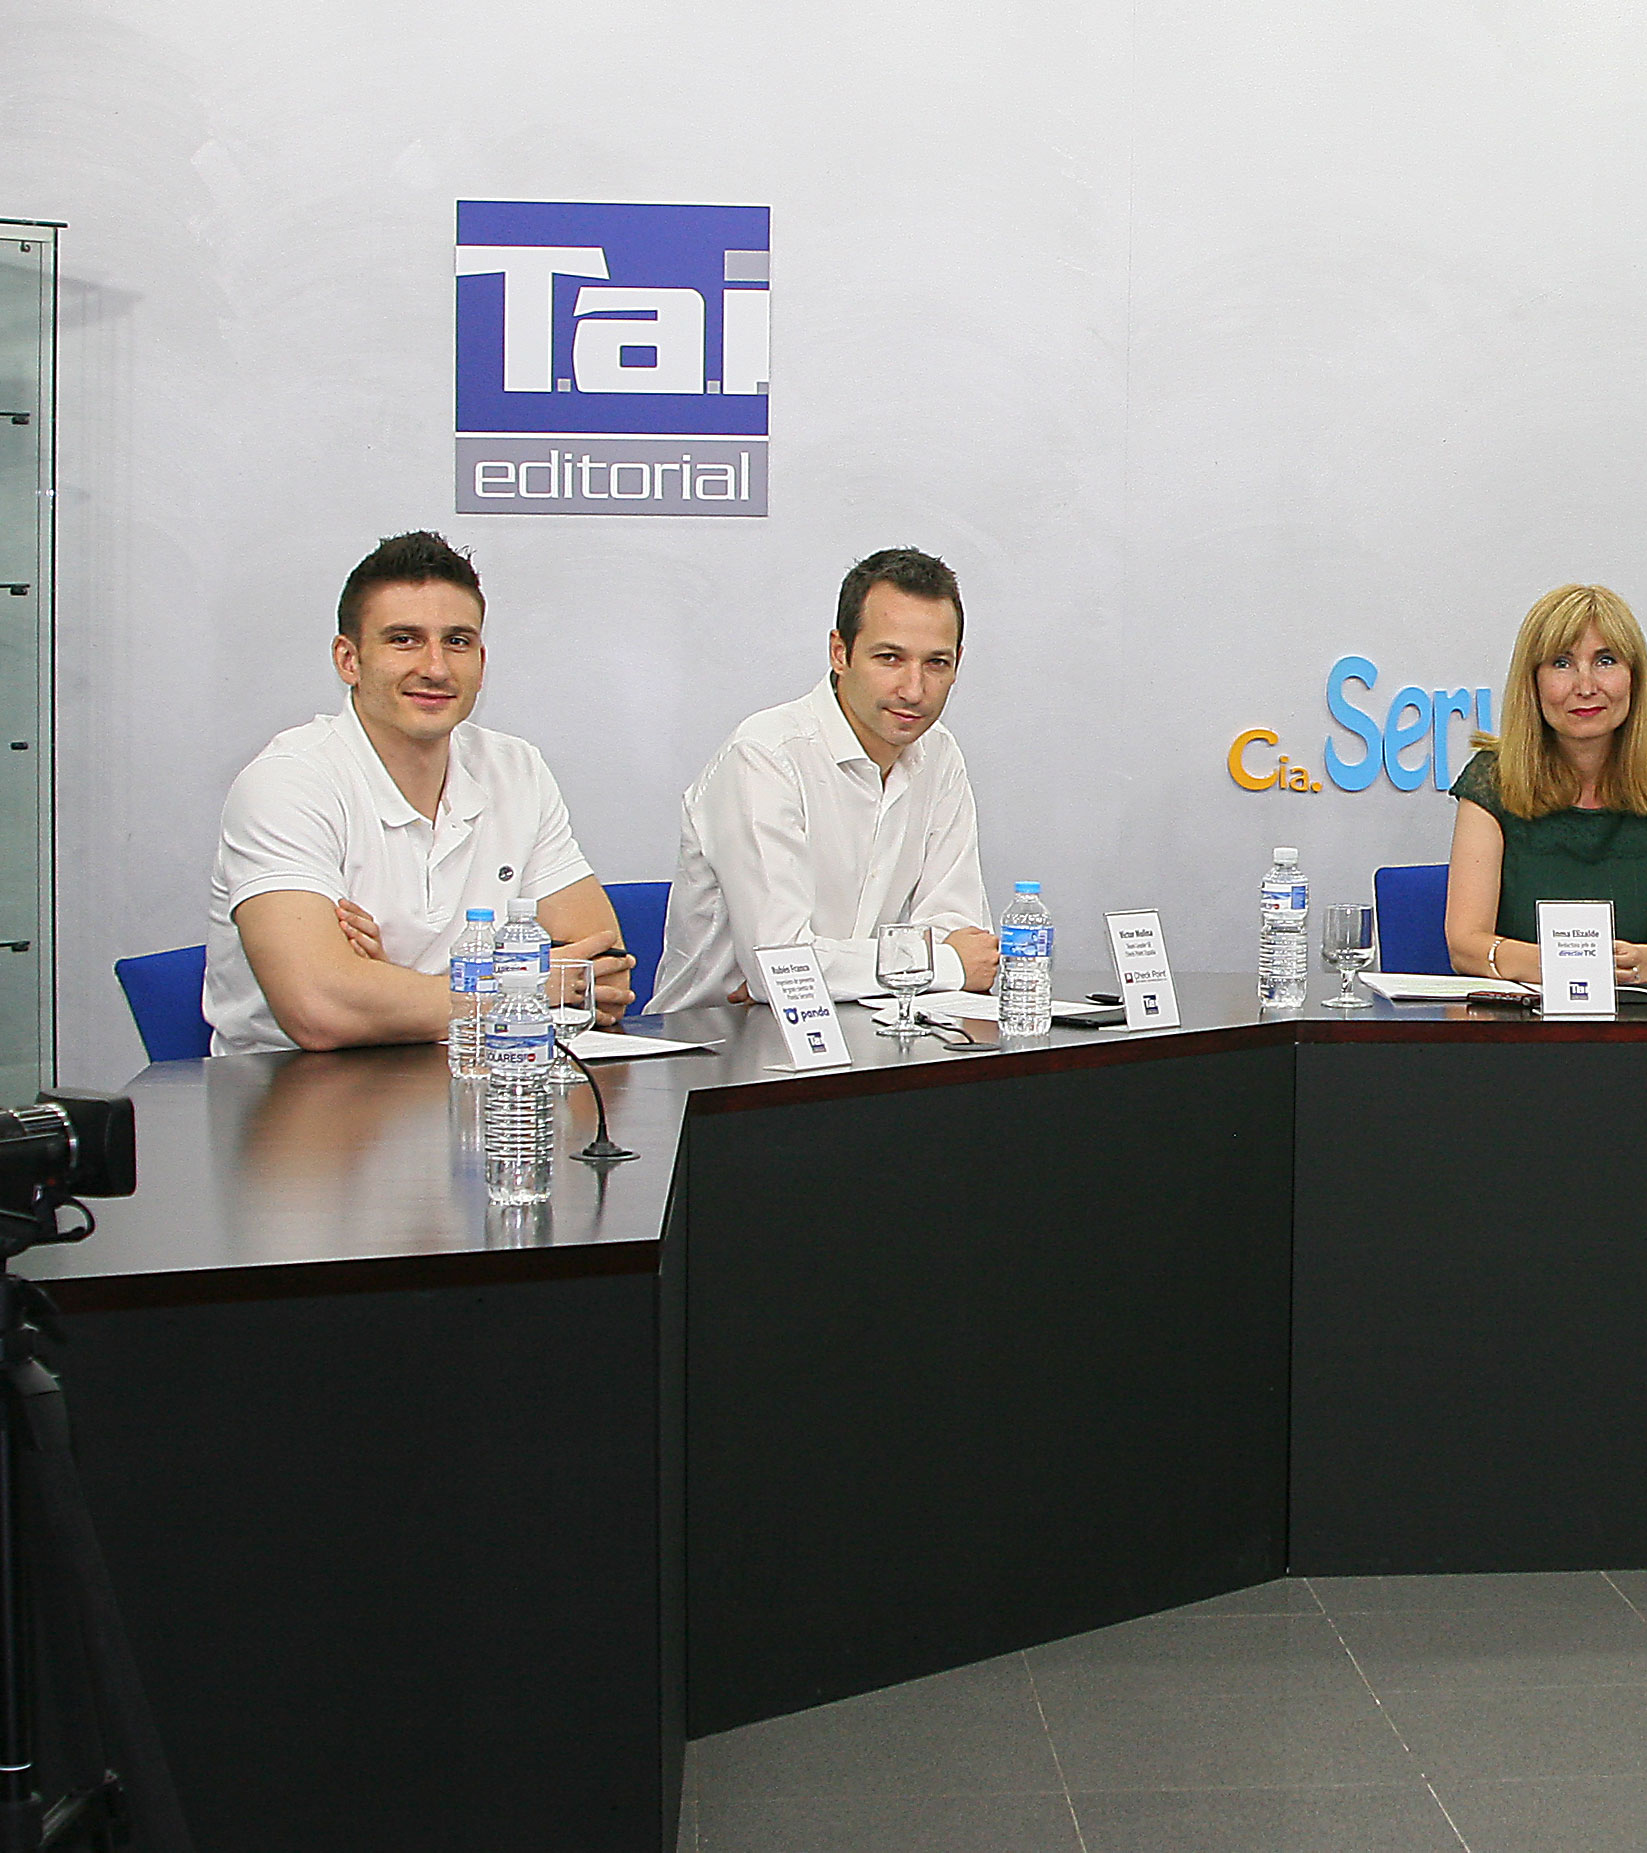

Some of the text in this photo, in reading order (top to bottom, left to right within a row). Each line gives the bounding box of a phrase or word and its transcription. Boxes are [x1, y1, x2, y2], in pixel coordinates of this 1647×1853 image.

[473, 449, 751, 501] editorial
[1228, 728, 1323, 793] Cia.
[1134, 971, 1151, 980] Check
[1151, 970, 1167, 978] Point
[800, 1005, 830, 1022] panda
